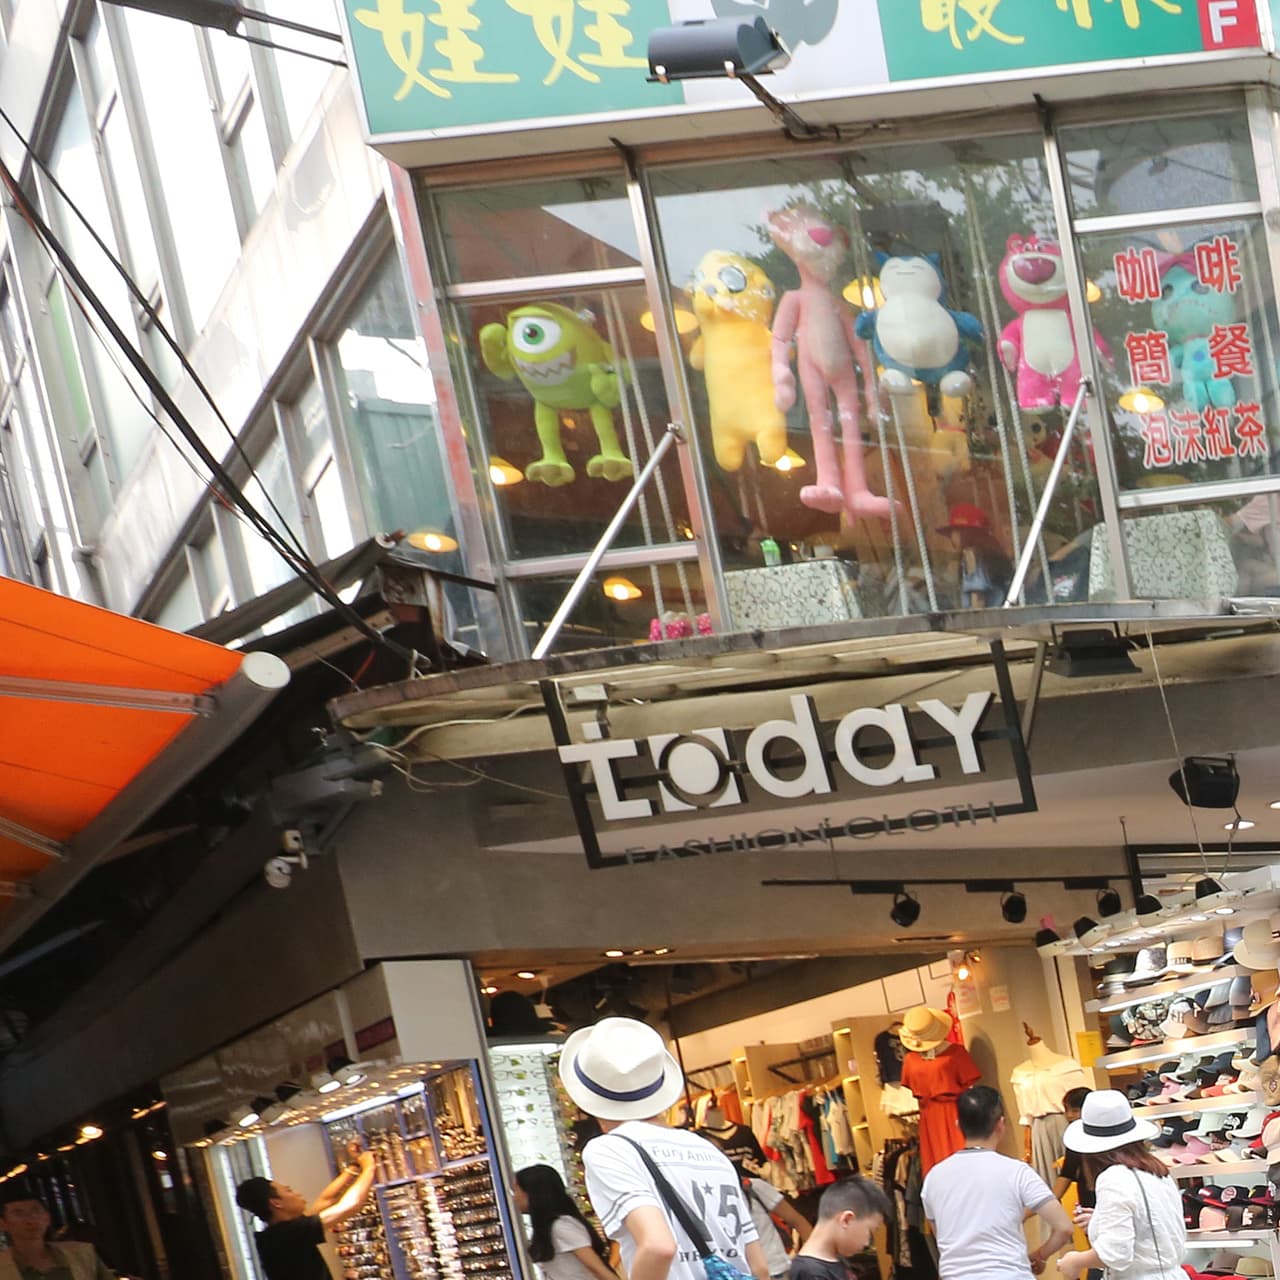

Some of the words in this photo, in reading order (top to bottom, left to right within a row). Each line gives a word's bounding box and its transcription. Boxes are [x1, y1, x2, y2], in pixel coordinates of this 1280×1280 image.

[1114, 235, 1242, 303] 咖啡
[1124, 325, 1254, 387] 簡餐
[1139, 401, 1269, 469] 泡沫紅茶
[624, 821, 834, 866] FASHION
[842, 799, 999, 841] CLOTH
